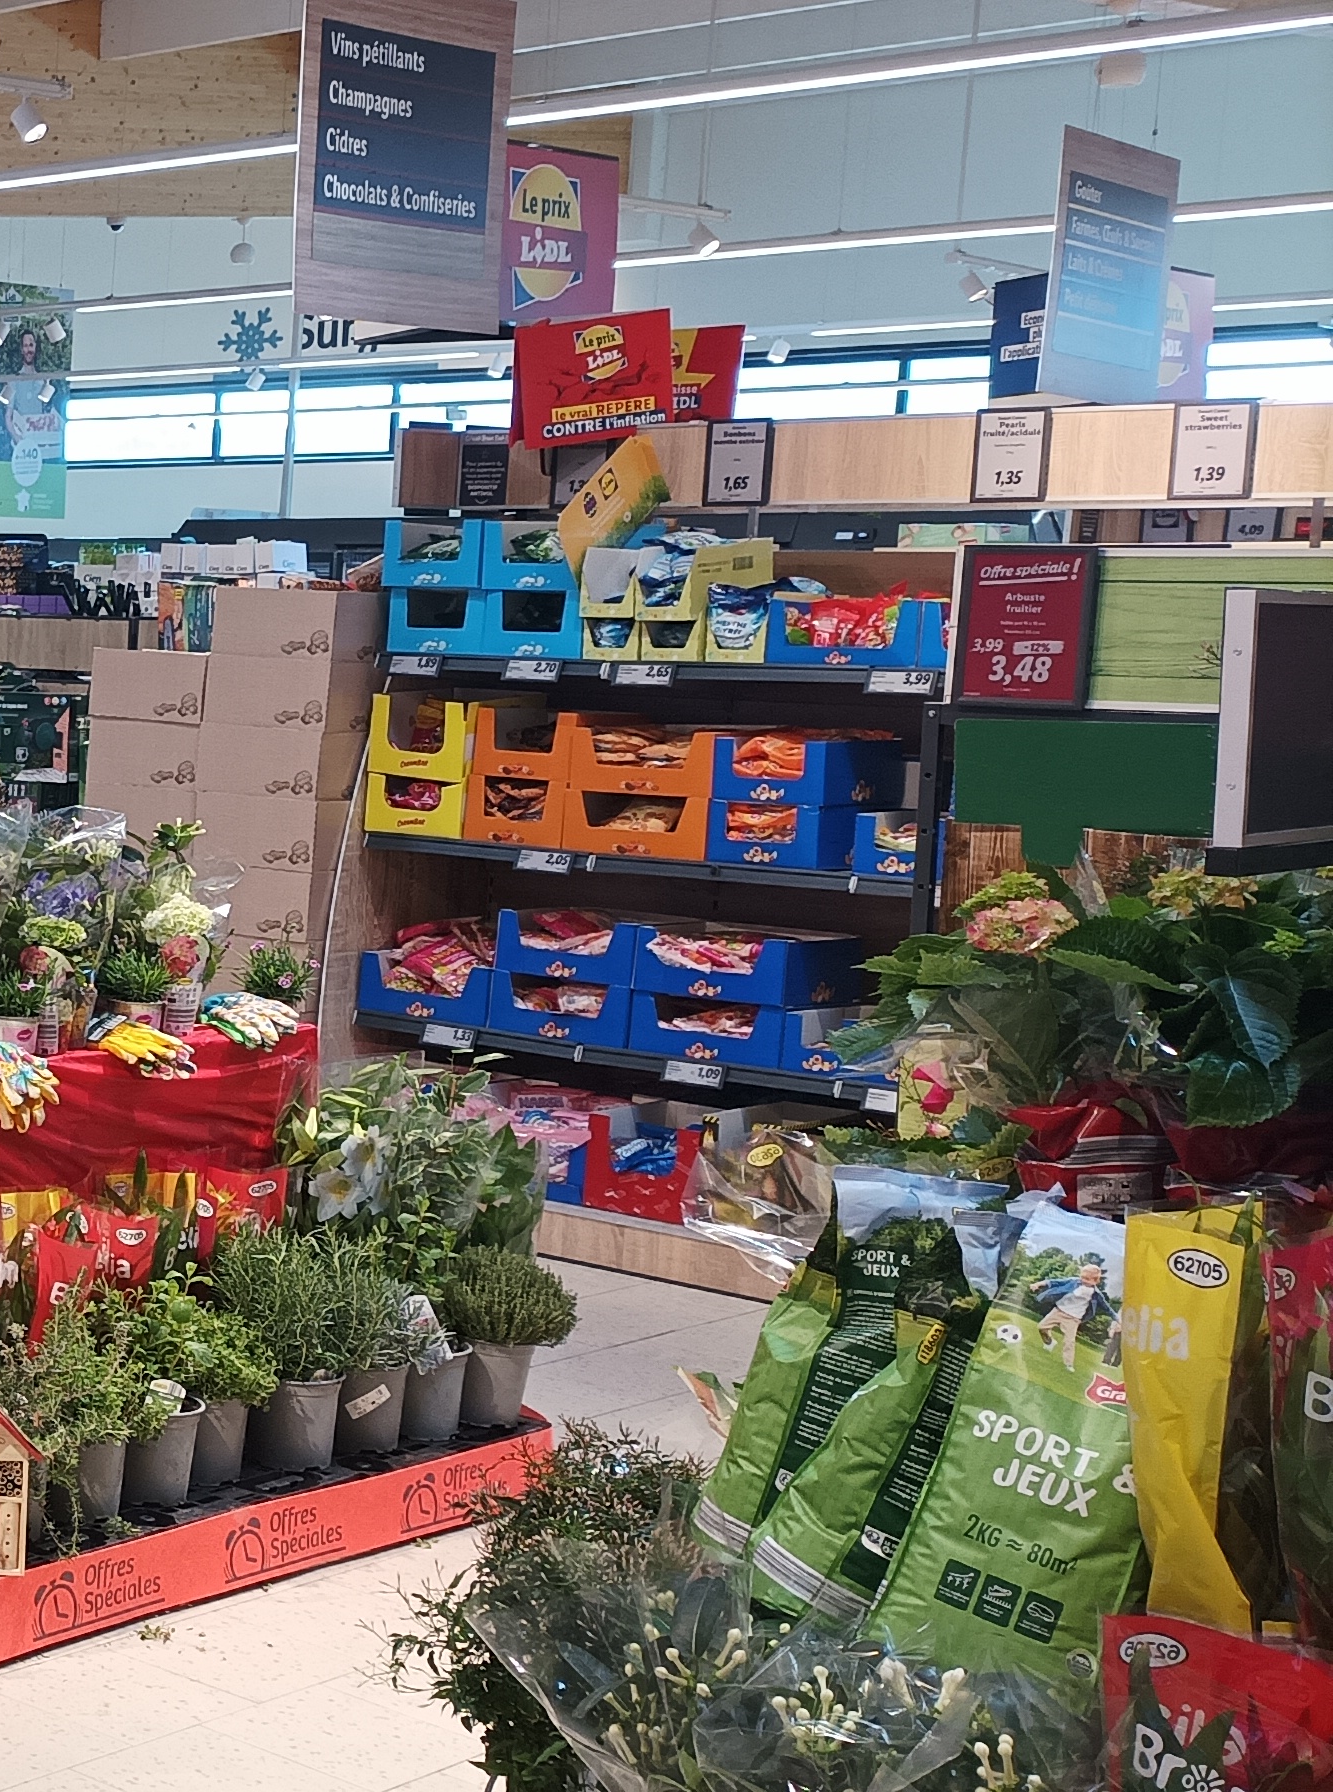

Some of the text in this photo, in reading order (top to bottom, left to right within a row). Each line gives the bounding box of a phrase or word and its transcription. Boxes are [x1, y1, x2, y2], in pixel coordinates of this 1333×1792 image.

[331, 31, 425, 74] Vins pétillants
[329, 80, 413, 121] Champagnes
[325, 127, 368, 158] Cidres
[323, 174, 476, 220] Chocolats & Confiseries
[522, 189, 572, 222] Le prix
[582, 331, 617, 349] Le prix
[555, 409, 566, 422] le
[569, 407, 593, 420] vrai
[1200, 414, 1228, 423] Sweet
[543, 411, 666, 438] CONTRE l'inflation
[999, 421, 1026, 430] Pearls
[1184, 422, 1243, 432] strawberries
[21, 447, 38, 460] 140
[994, 470, 1024, 487] 1,35
[1193, 466, 1226, 484] 1,39
[723, 476, 750, 492] 1,65
[1238, 524, 1265, 536] 4,09
[84, 573, 102, 583] Cien
[980, 564, 1015, 579] Offre
[1015, 561, 1070, 578] spéciale
[1005, 592, 1046, 602] Arbuste
[1006, 604, 1042, 613] fruitier
[971, 638, 1005, 653] 3,99
[416, 657, 438, 669] 1,89
[533, 662, 557, 674] 2,70
[988, 655, 1053, 686] 3,48
[645, 666, 670, 679] 2,65
[902, 672, 931, 686] 3,99
[545, 854, 569, 867] 2,05
[451, 1029, 473, 1043] 1,33
[697, 1066, 721, 1080] 1,09
[851, 1248, 912, 1267] SPORT &
[863, 1263, 900, 1278] JEUX
[1173, 1255, 1223, 1281] 62705
[972, 1409, 1100, 1478] SPORT
[444, 1462, 484, 1491] Offres
[992, 1458, 1097, 1518] JEUX
[270, 1504, 317, 1536] Offres
[963, 1513, 1003, 1548] 2KG
[270, 1523, 344, 1562] Spéciales
[83, 1557, 135, 1591] Offres
[83, 1573, 162, 1618] Spéciales
